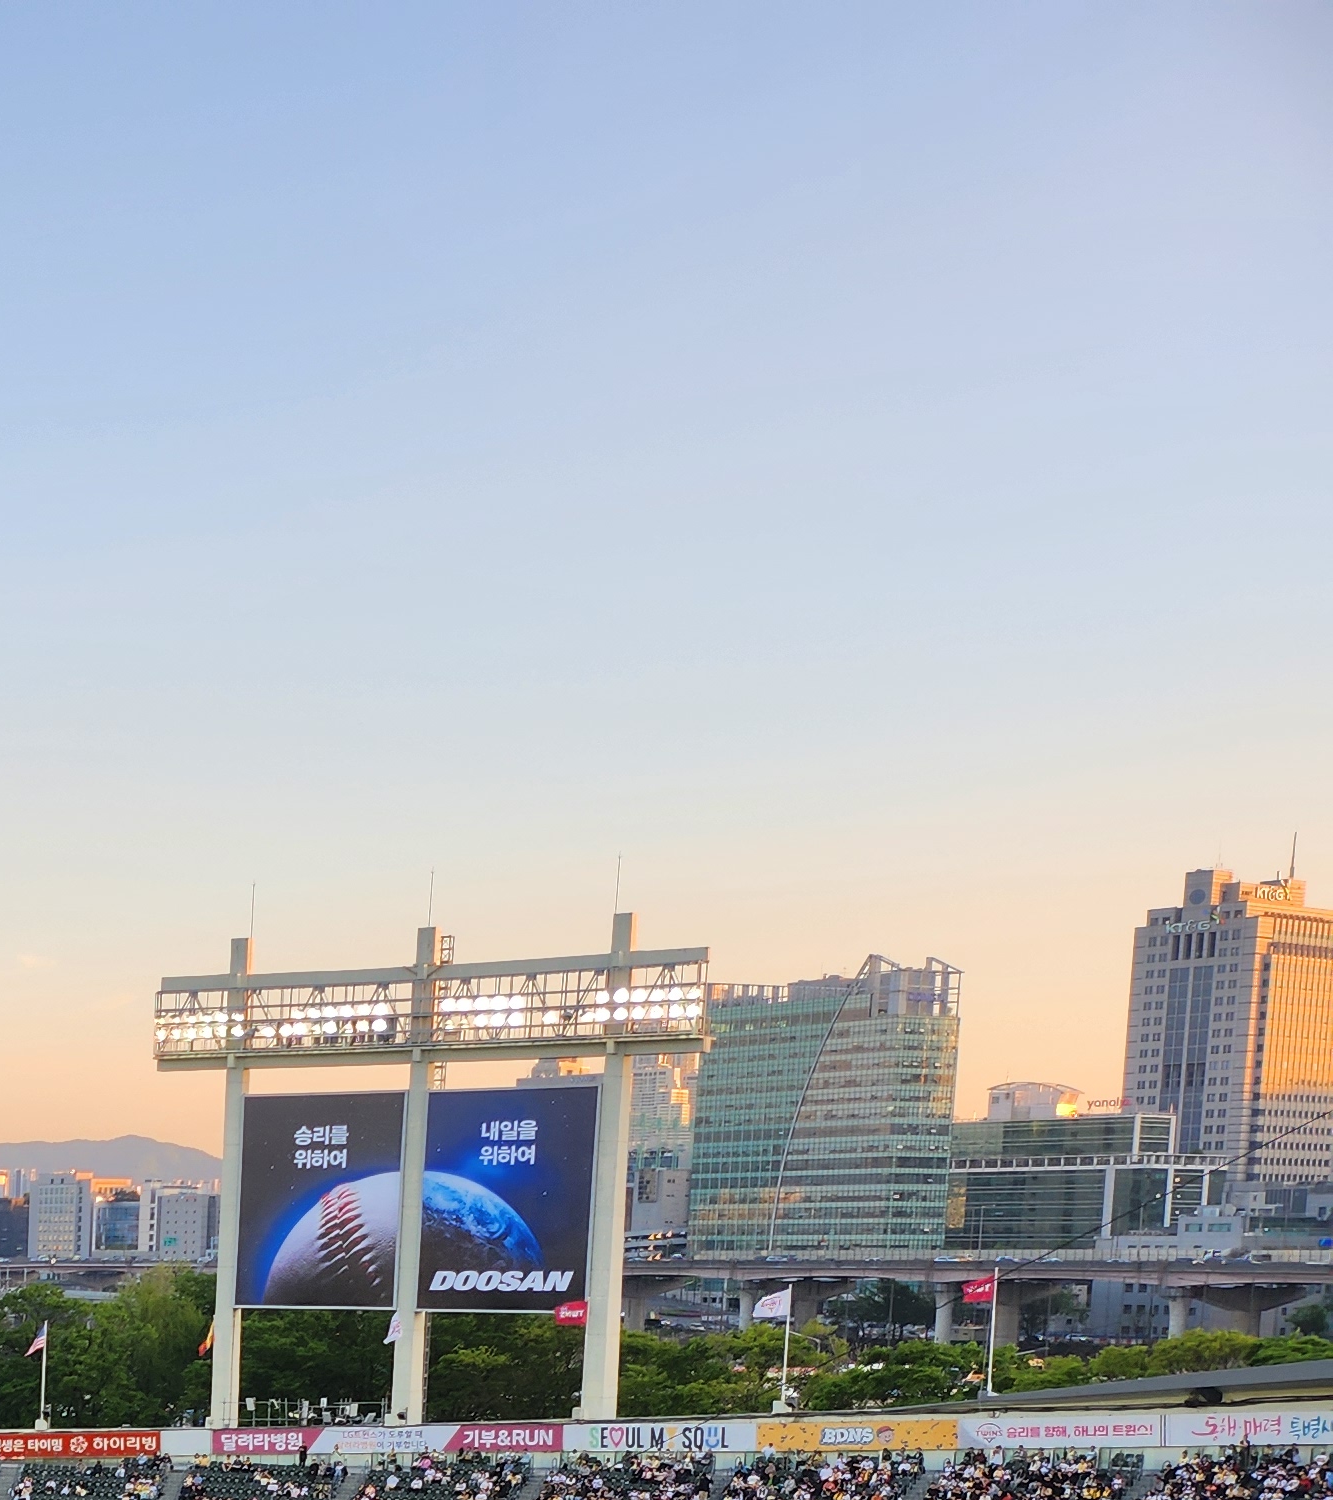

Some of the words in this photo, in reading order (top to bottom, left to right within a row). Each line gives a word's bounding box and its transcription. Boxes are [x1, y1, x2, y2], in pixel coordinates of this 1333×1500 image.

[1254, 886, 1283, 902] KT&G
[1165, 917, 1211, 934] KT&G
[294, 1125, 349, 1146] 승리를
[480, 1120, 539, 1141] 내일을
[293, 1149, 348, 1169] 위하여
[479, 1145, 536, 1166] 위하여
[429, 1270, 574, 1293] DOOSAN
[463, 1430, 554, 1448] 기부&RUN
[820, 1427, 873, 1446] BDNS
[976, 1430, 1002, 1438] TWINS
[1007, 1426, 1040, 1439] 승리를
[1044, 1426, 1071, 1439] 향해,
[1074, 1425, 1109, 1438] 하나의
[1112, 1424, 1153, 1437] 트윈스!
[27, 1438, 63, 1452] 타이밍
[93, 1437, 156, 1451] 하이리빙
[220, 1432, 303, 1452] 달려라병원
